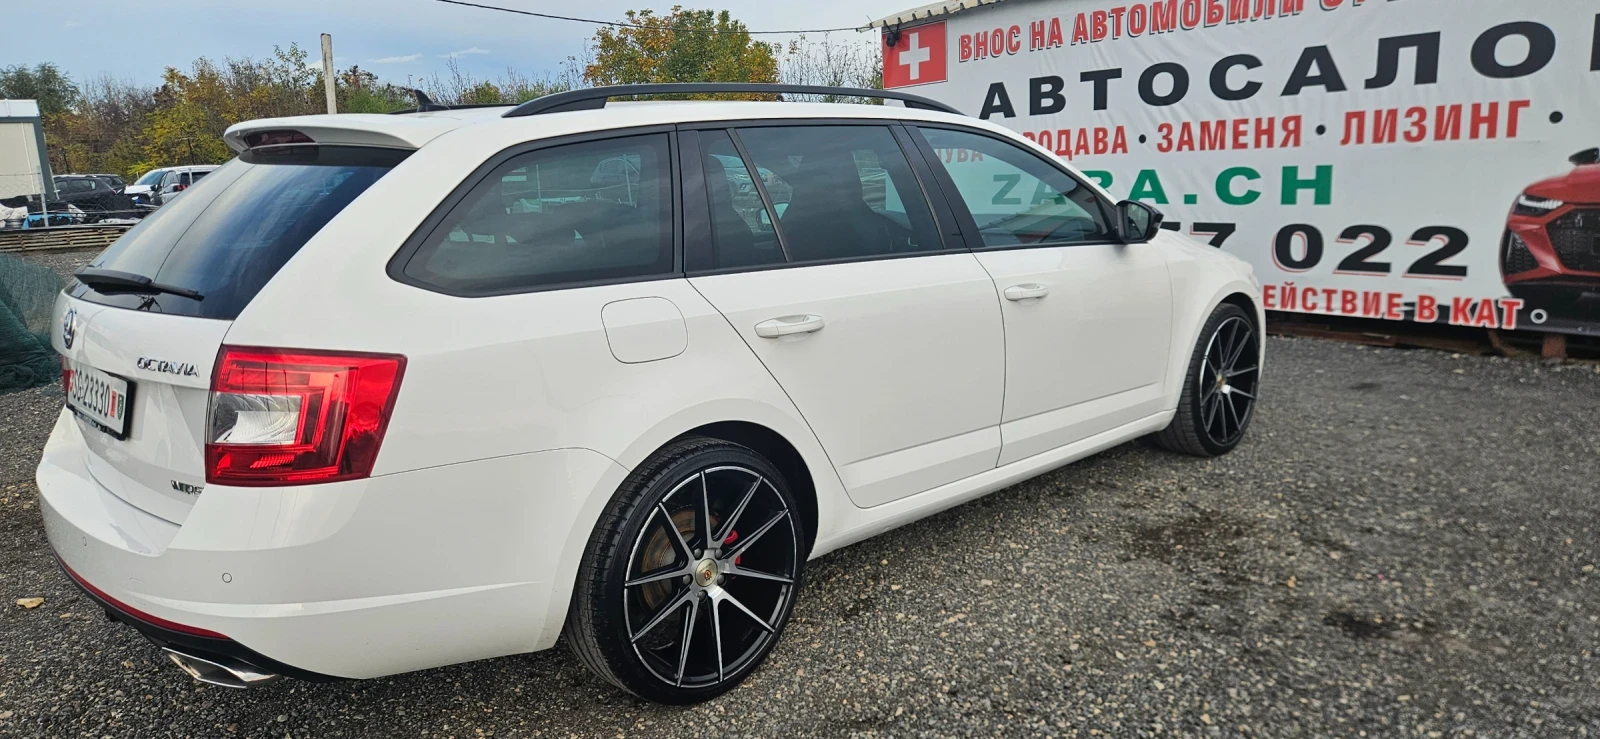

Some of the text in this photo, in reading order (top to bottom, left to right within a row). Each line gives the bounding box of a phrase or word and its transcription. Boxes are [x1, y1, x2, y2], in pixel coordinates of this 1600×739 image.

[958, 25, 1021, 62] ВНОС
[1029, 17, 1063, 51] НА
[979, 13, 1600, 121] АВТОСАЛО
[1157, 114, 1303, 153] ЗАМЕНЯ
[1339, 100, 1531, 146] ЛИЗИНГ
[1271, 222, 1470, 280] 022
[1414, 295, 1438, 322] В
[1450, 296, 1524, 330] КАТ
[137, 357, 200, 378] OCTAVIA
